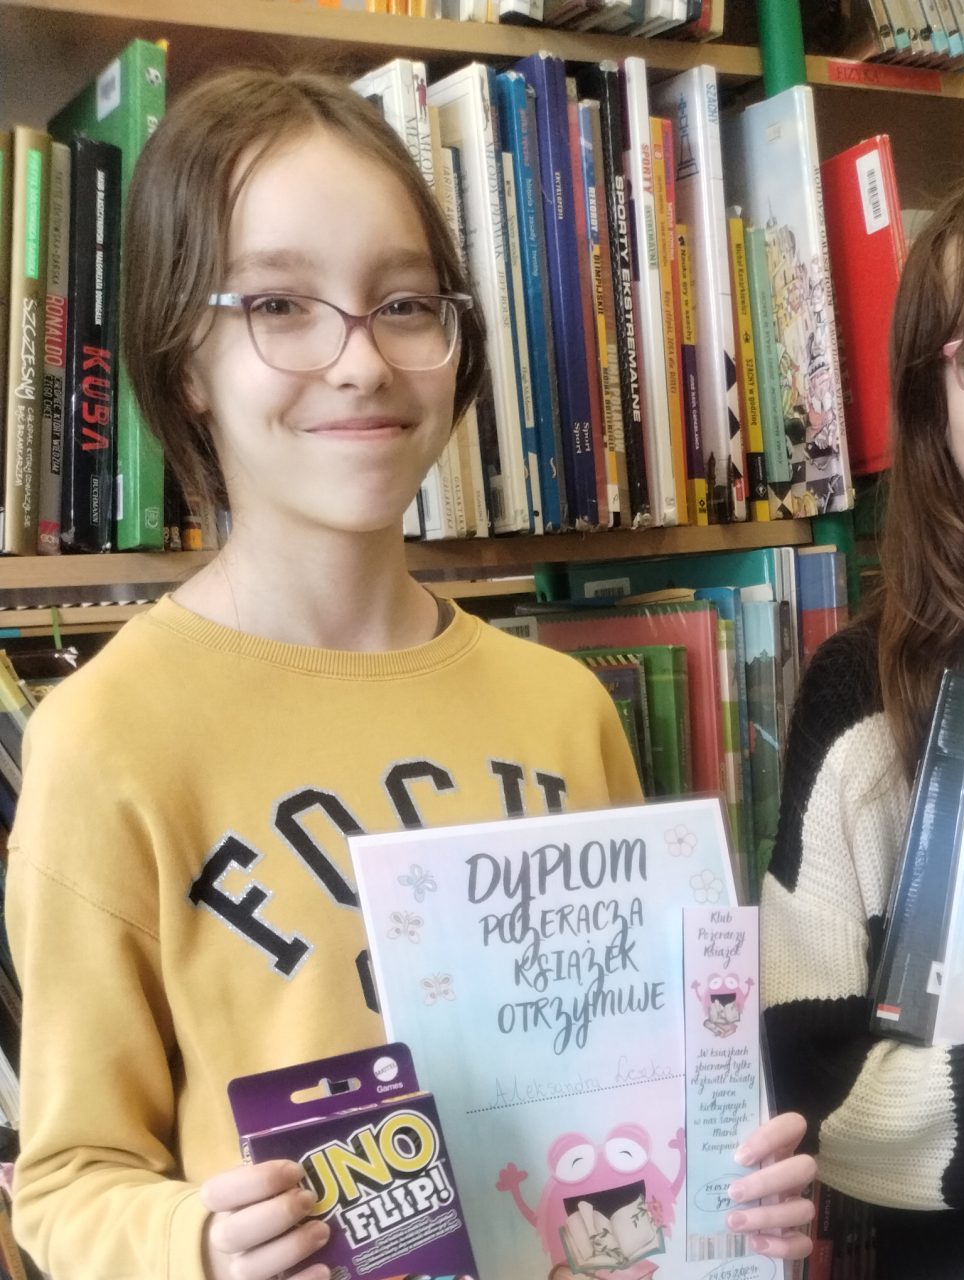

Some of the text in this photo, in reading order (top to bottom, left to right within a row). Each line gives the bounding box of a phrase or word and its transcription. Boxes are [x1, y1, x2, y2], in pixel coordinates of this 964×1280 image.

[706, 83, 718, 125] SZACHY
[641, 143, 654, 194] SPORTY
[735, 242, 744, 268] Michał
[614, 174, 641, 423] SPORTY EKSTREMALNE
[44, 295, 66, 368] RONALDO
[81, 345, 112, 452] KUBA
[833, 385, 846, 437] NATALIA
[572, 421, 582, 455] Sport
[582, 421, 591, 452] Sport
[465, 838, 648, 912] DYPLOM
[479, 898, 645, 957] POŻERACZA
[710, 911, 733, 924] Klub
[514, 939, 640, 992] KSIĄŻEK
[498, 981, 666, 1055] OTRZYMUJE
[376, 1082, 404, 1094] Games
[300, 1110, 438, 1219] UNO
[345, 1163, 454, 1248] FLIP!
